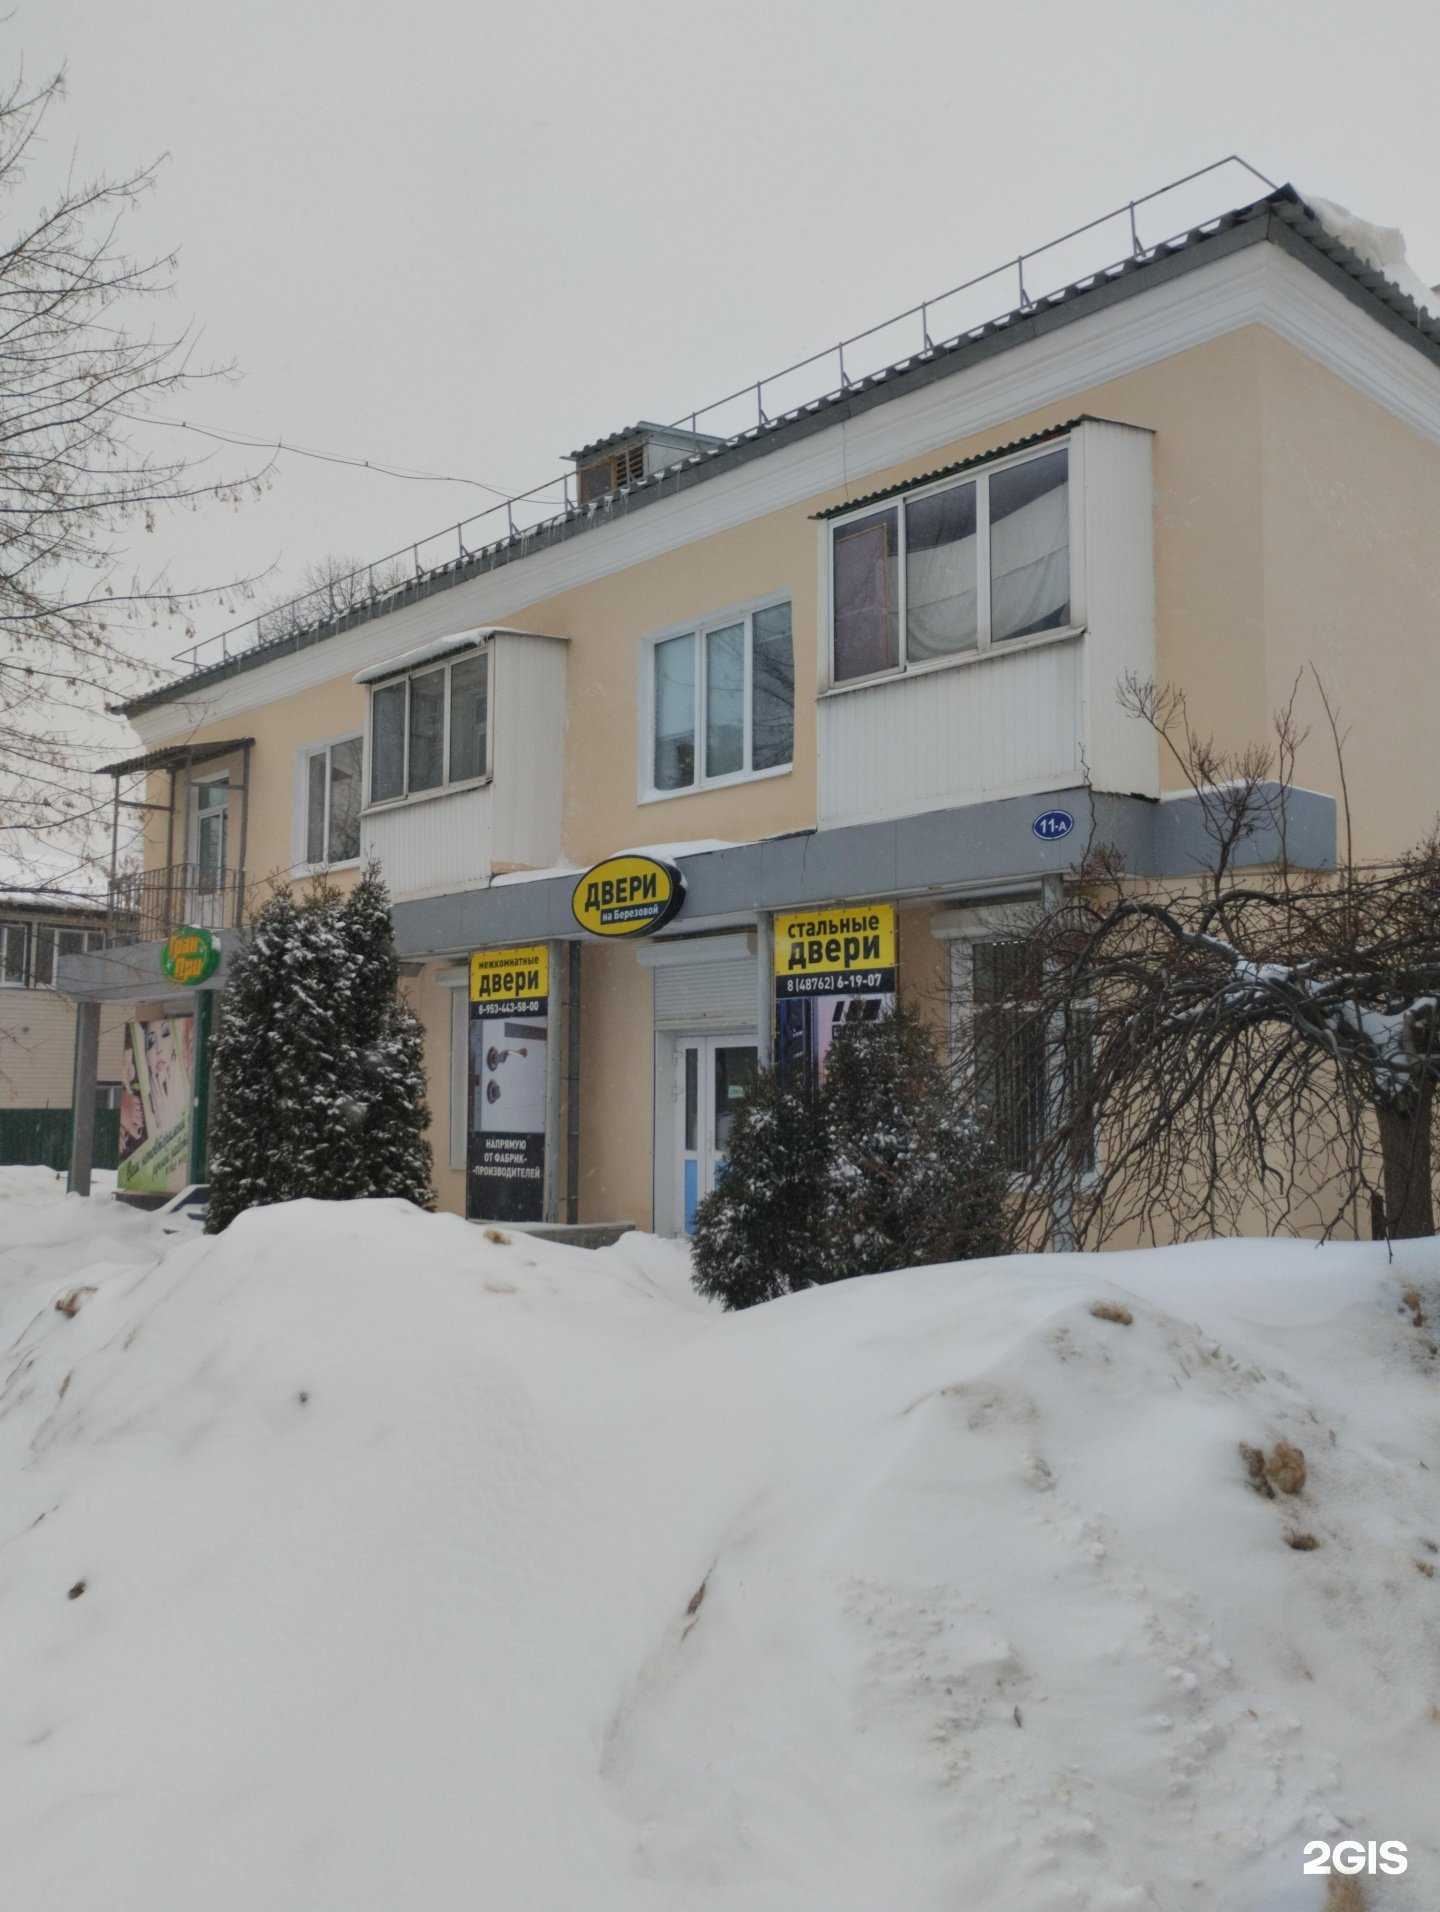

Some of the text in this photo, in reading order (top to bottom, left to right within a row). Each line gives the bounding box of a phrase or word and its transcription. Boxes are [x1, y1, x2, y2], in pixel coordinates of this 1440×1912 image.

[584, 873, 657, 912] ДВЕРИ
[602, 904, 658, 921] на Березовой
[788, 915, 880, 938] стальные
[788, 935, 880, 970] двери
[479, 956, 539, 969] межкомнатные
[479, 970, 539, 997] двери
[787, 973, 882, 992] 8 (48762) 6-19-07
[485, 1139, 527, 1150] НАПРЯМУЮ
[484, 1153, 527, 1164] ОТ ФАБРИК-
